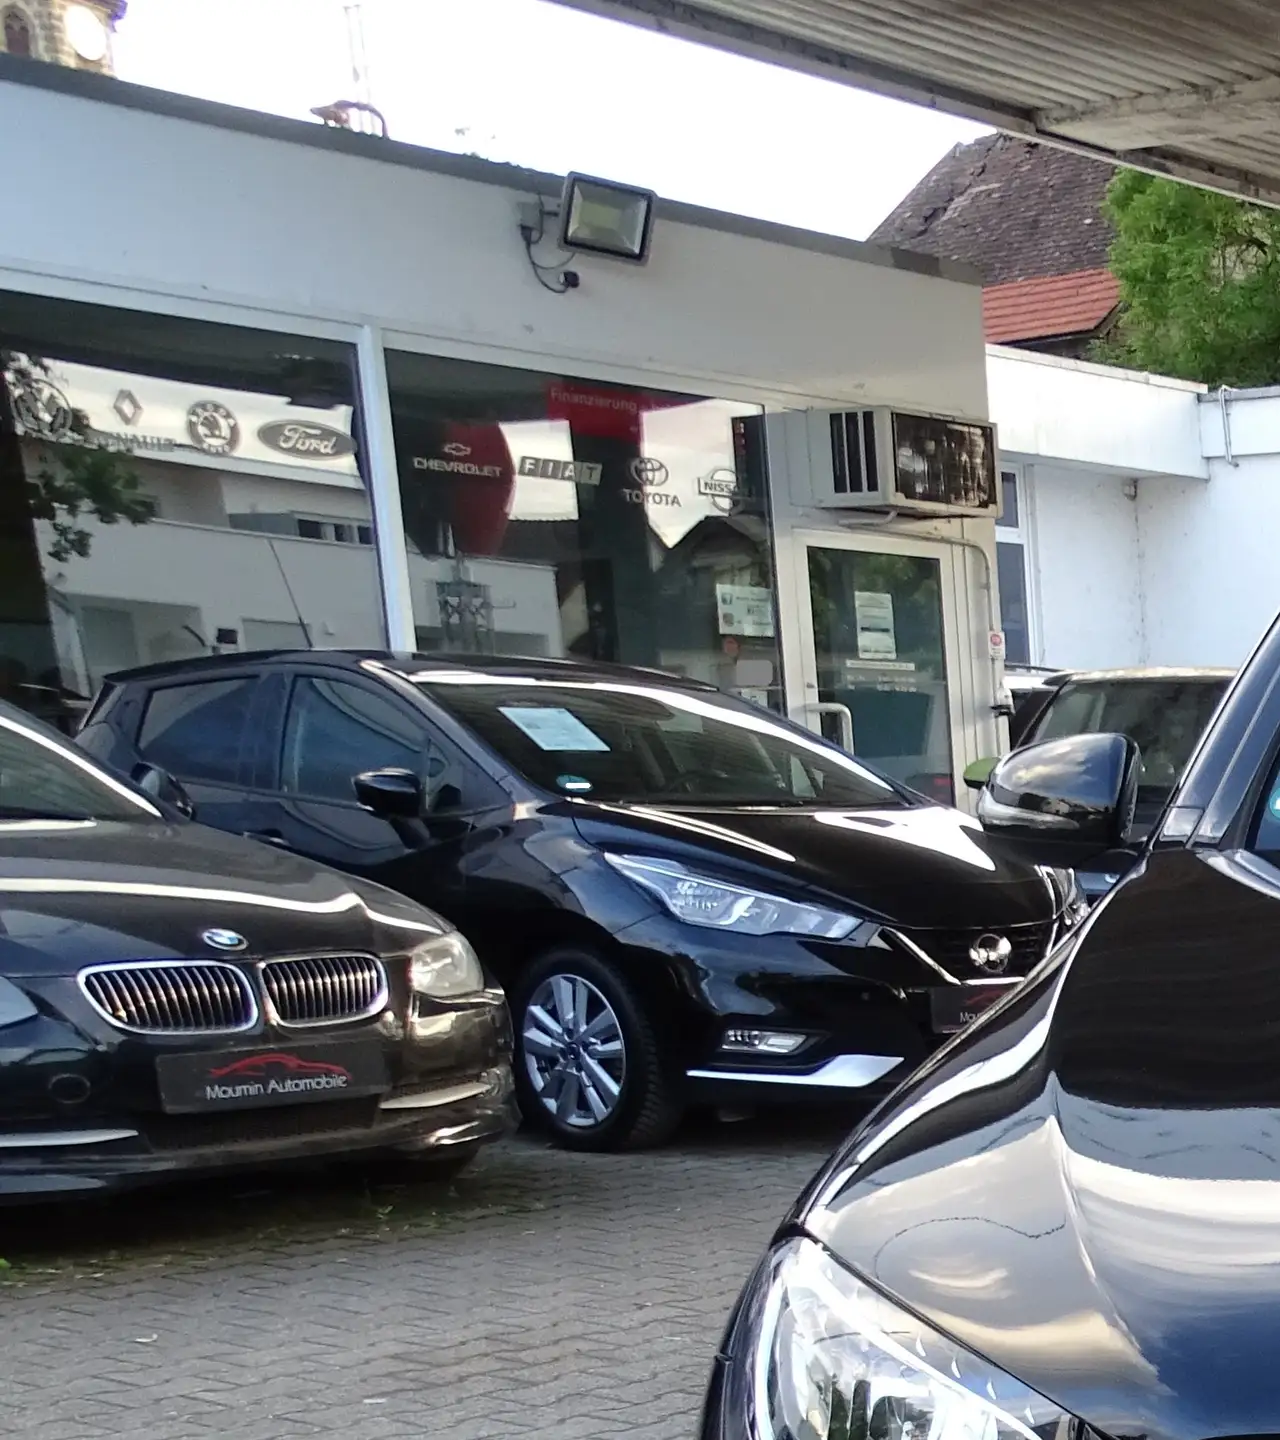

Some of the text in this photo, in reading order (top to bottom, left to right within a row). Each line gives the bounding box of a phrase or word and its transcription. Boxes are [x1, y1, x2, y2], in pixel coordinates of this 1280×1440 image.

[551, 388, 638, 413] Finanzierung
[279, 424, 337, 454] Ford
[413, 457, 502, 478] CHEVROLET
[525, 458, 598, 481] FIAT
[622, 488, 682, 507] TOYOTA
[205, 1074, 347, 1100] Moumin Automobile
